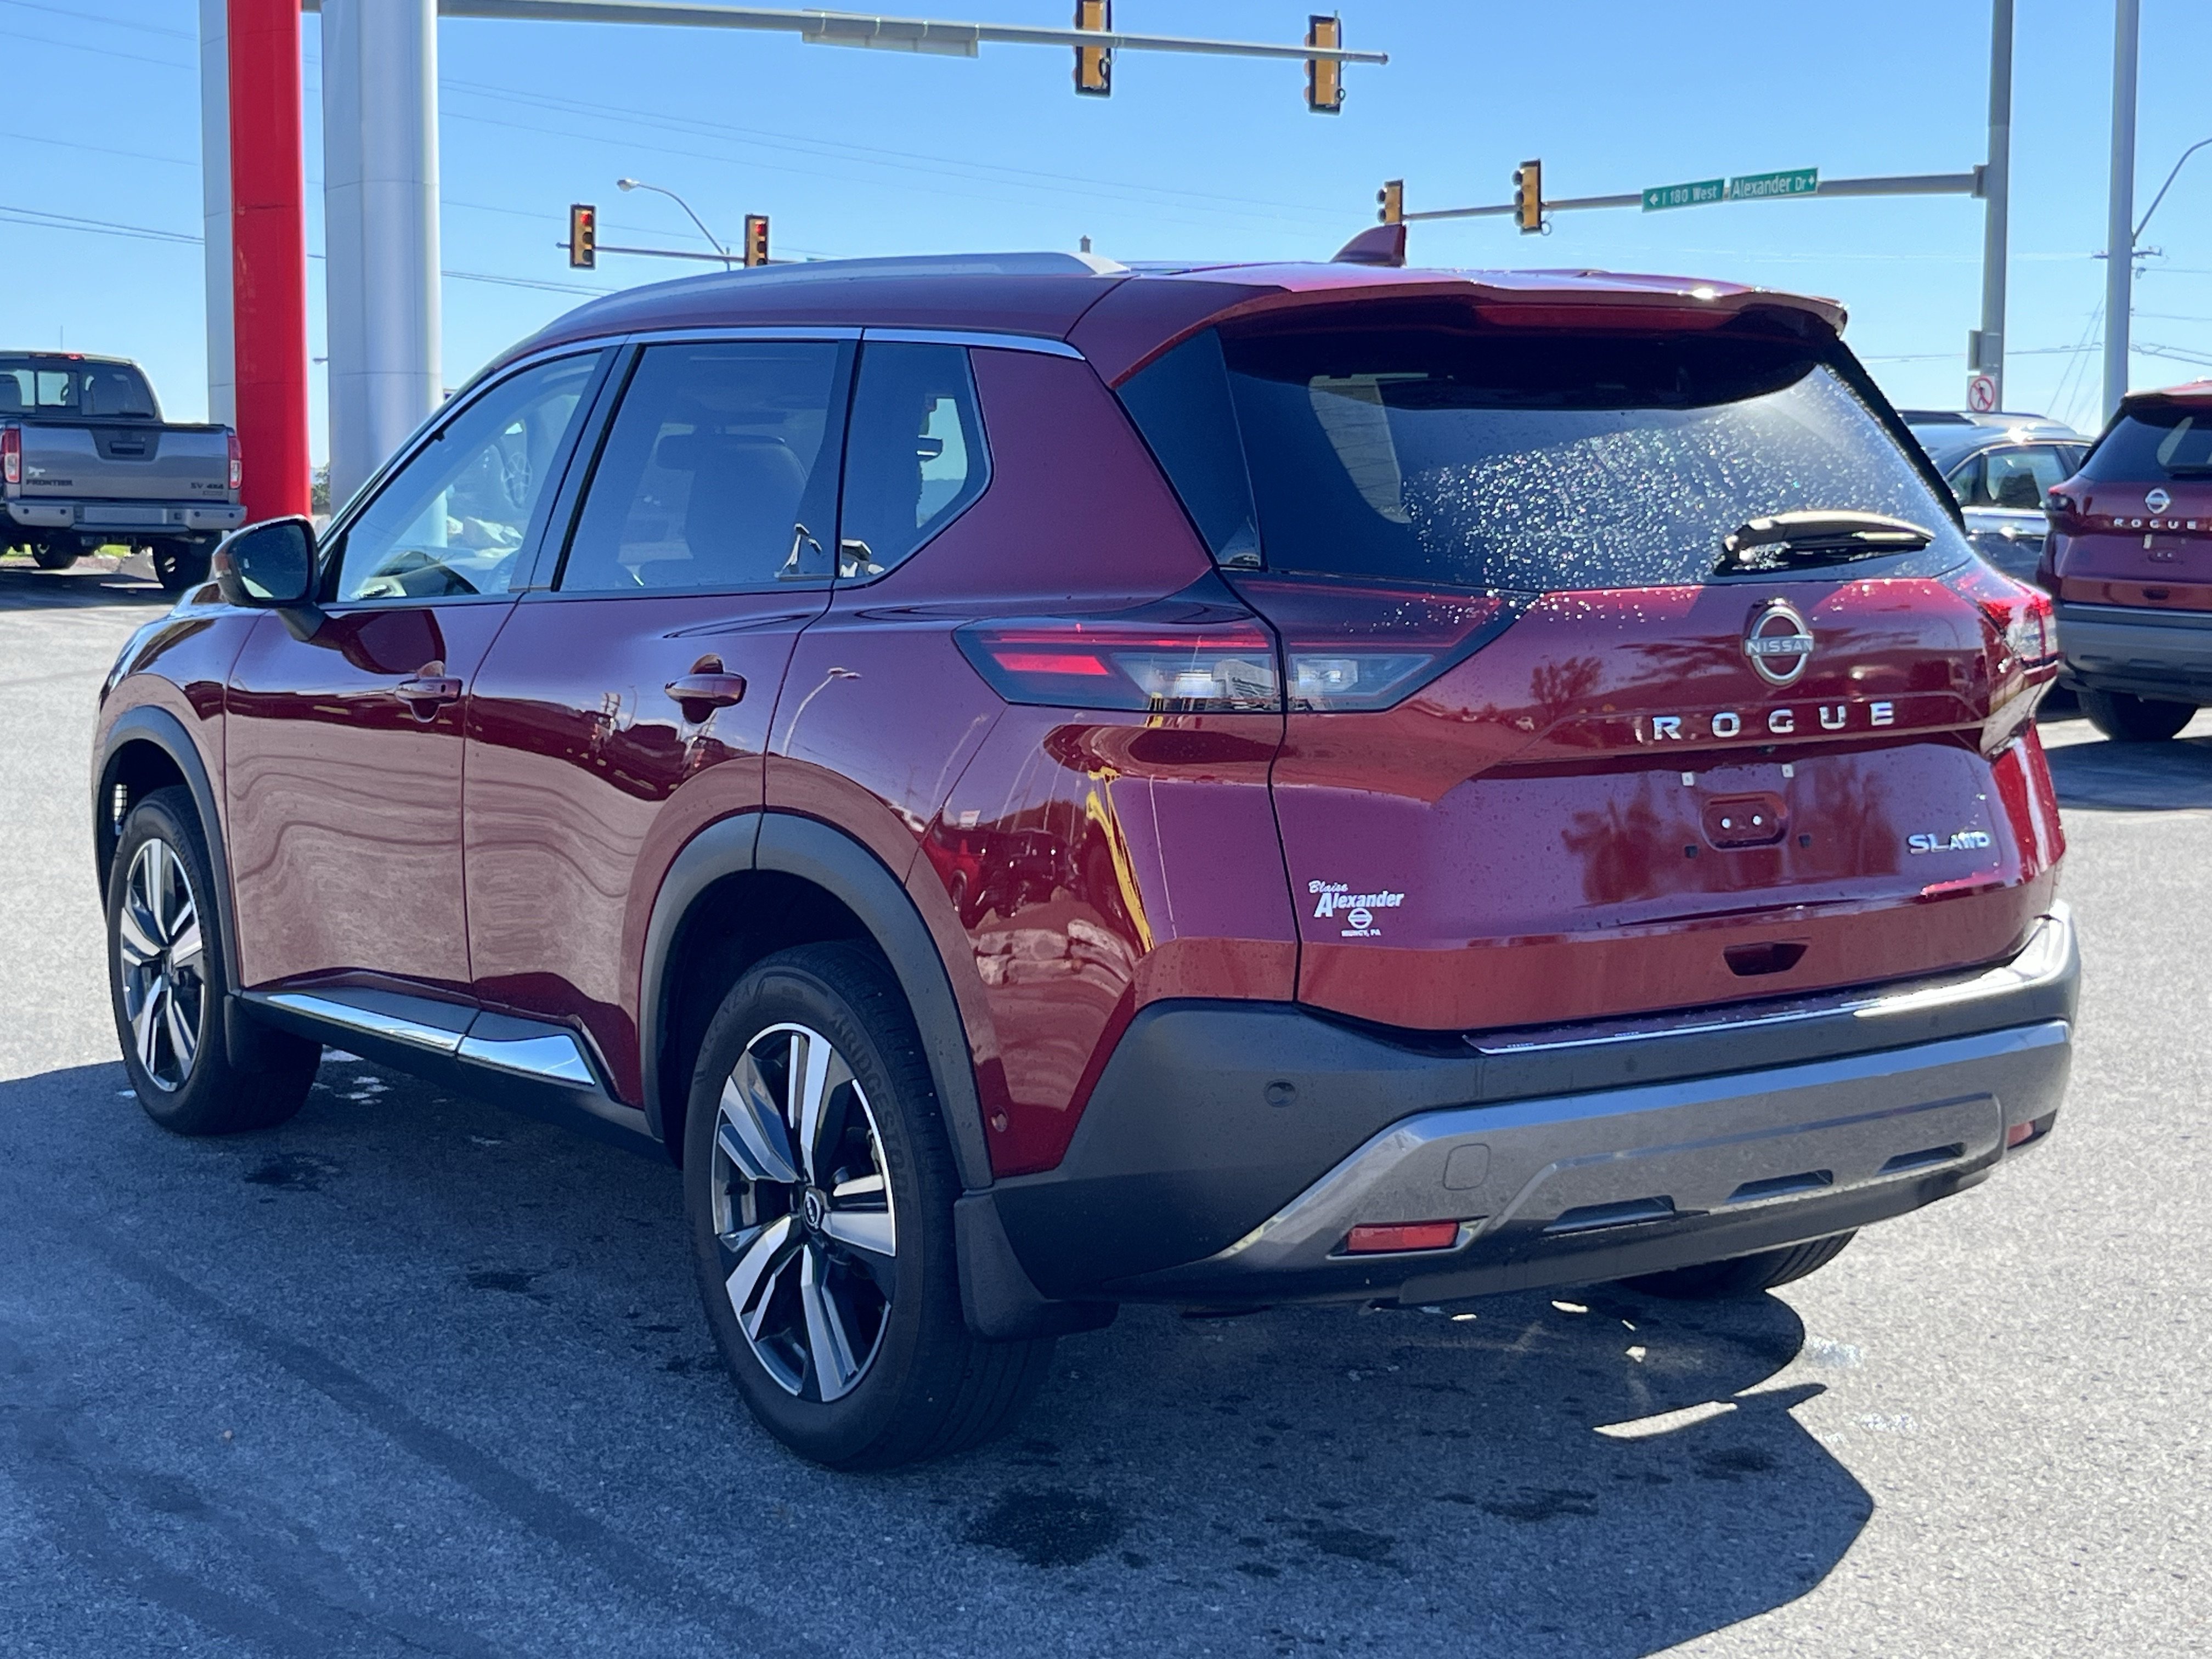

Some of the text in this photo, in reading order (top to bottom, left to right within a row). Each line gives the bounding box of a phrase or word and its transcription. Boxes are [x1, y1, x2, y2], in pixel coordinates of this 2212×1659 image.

[1662, 185, 1717, 205] I 180 West
[1733, 176, 1806, 197] Alexander Dr
[2114, 518, 2196, 530] ROGUE
[1746, 639, 1813, 653] NISSAN
[1652, 702, 1894, 741] ROGUE
[1308, 880, 1348, 893] Blaise
[1313, 890, 1404, 917] Alexander
